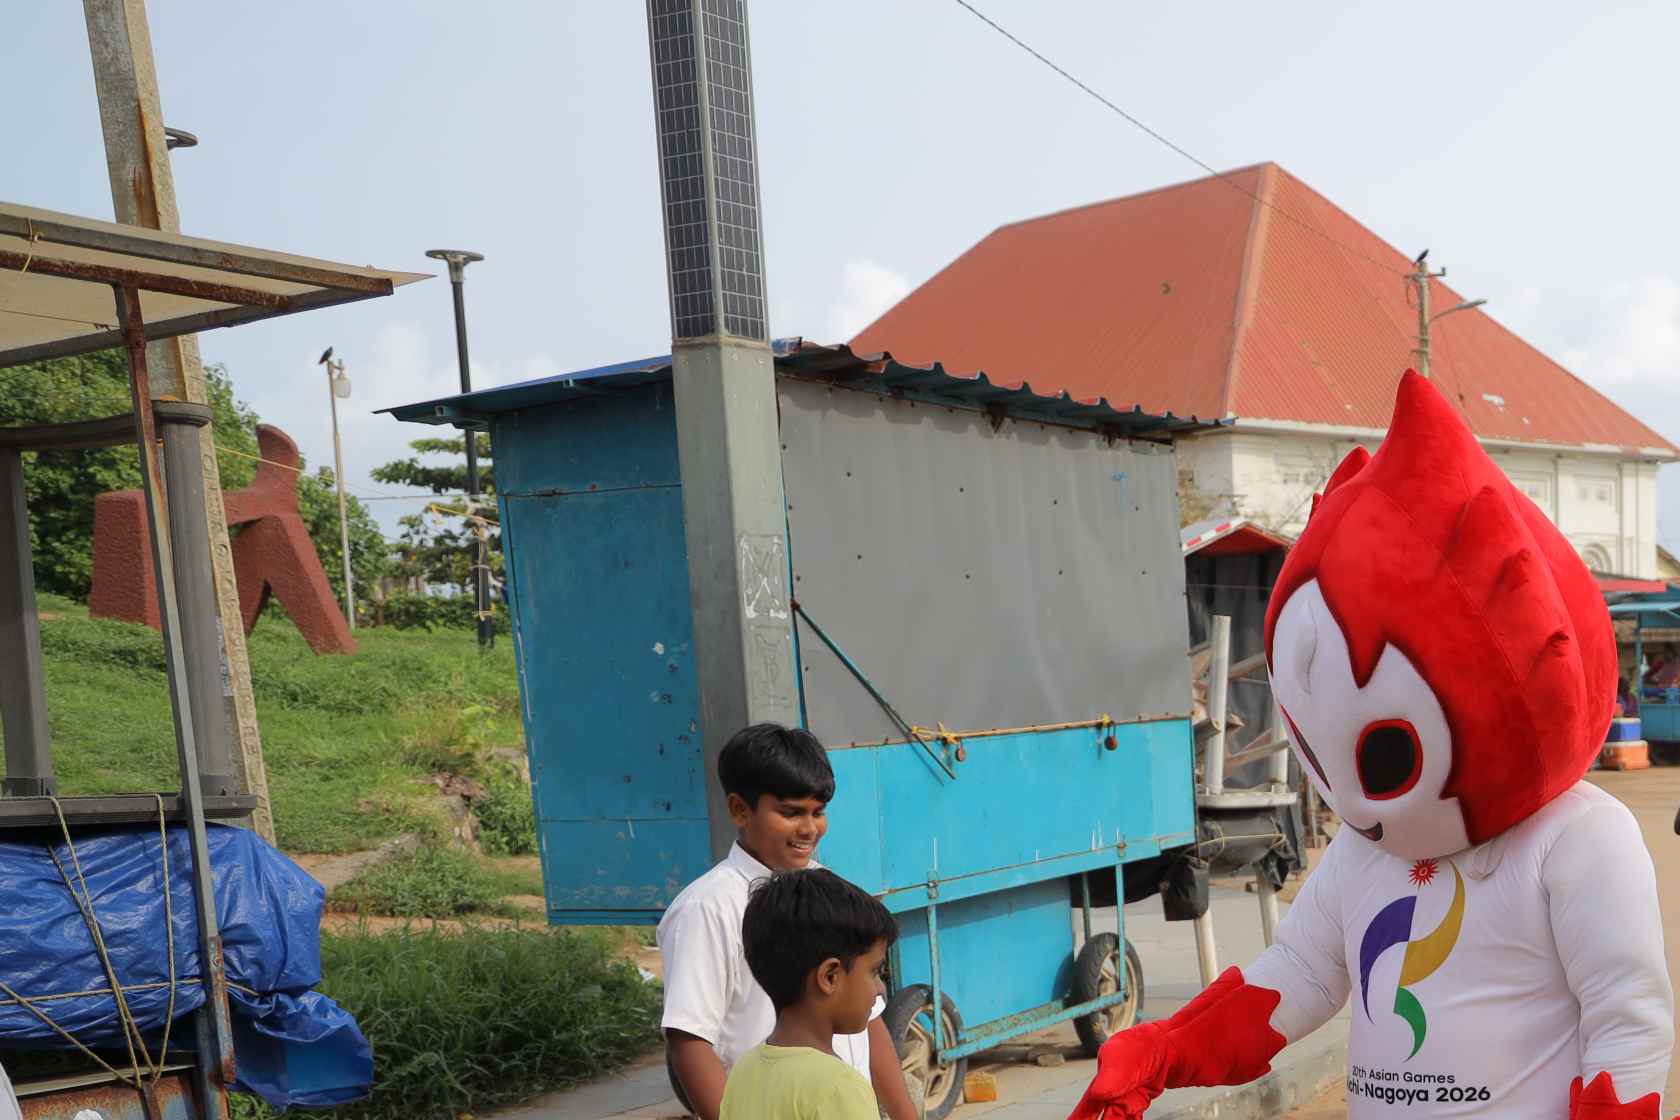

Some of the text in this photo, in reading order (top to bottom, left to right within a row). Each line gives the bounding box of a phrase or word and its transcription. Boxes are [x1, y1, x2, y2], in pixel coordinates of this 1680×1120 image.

[1352, 1065, 1455, 1084] 20th Asian Games
[1436, 1086, 1490, 1102] 2026
